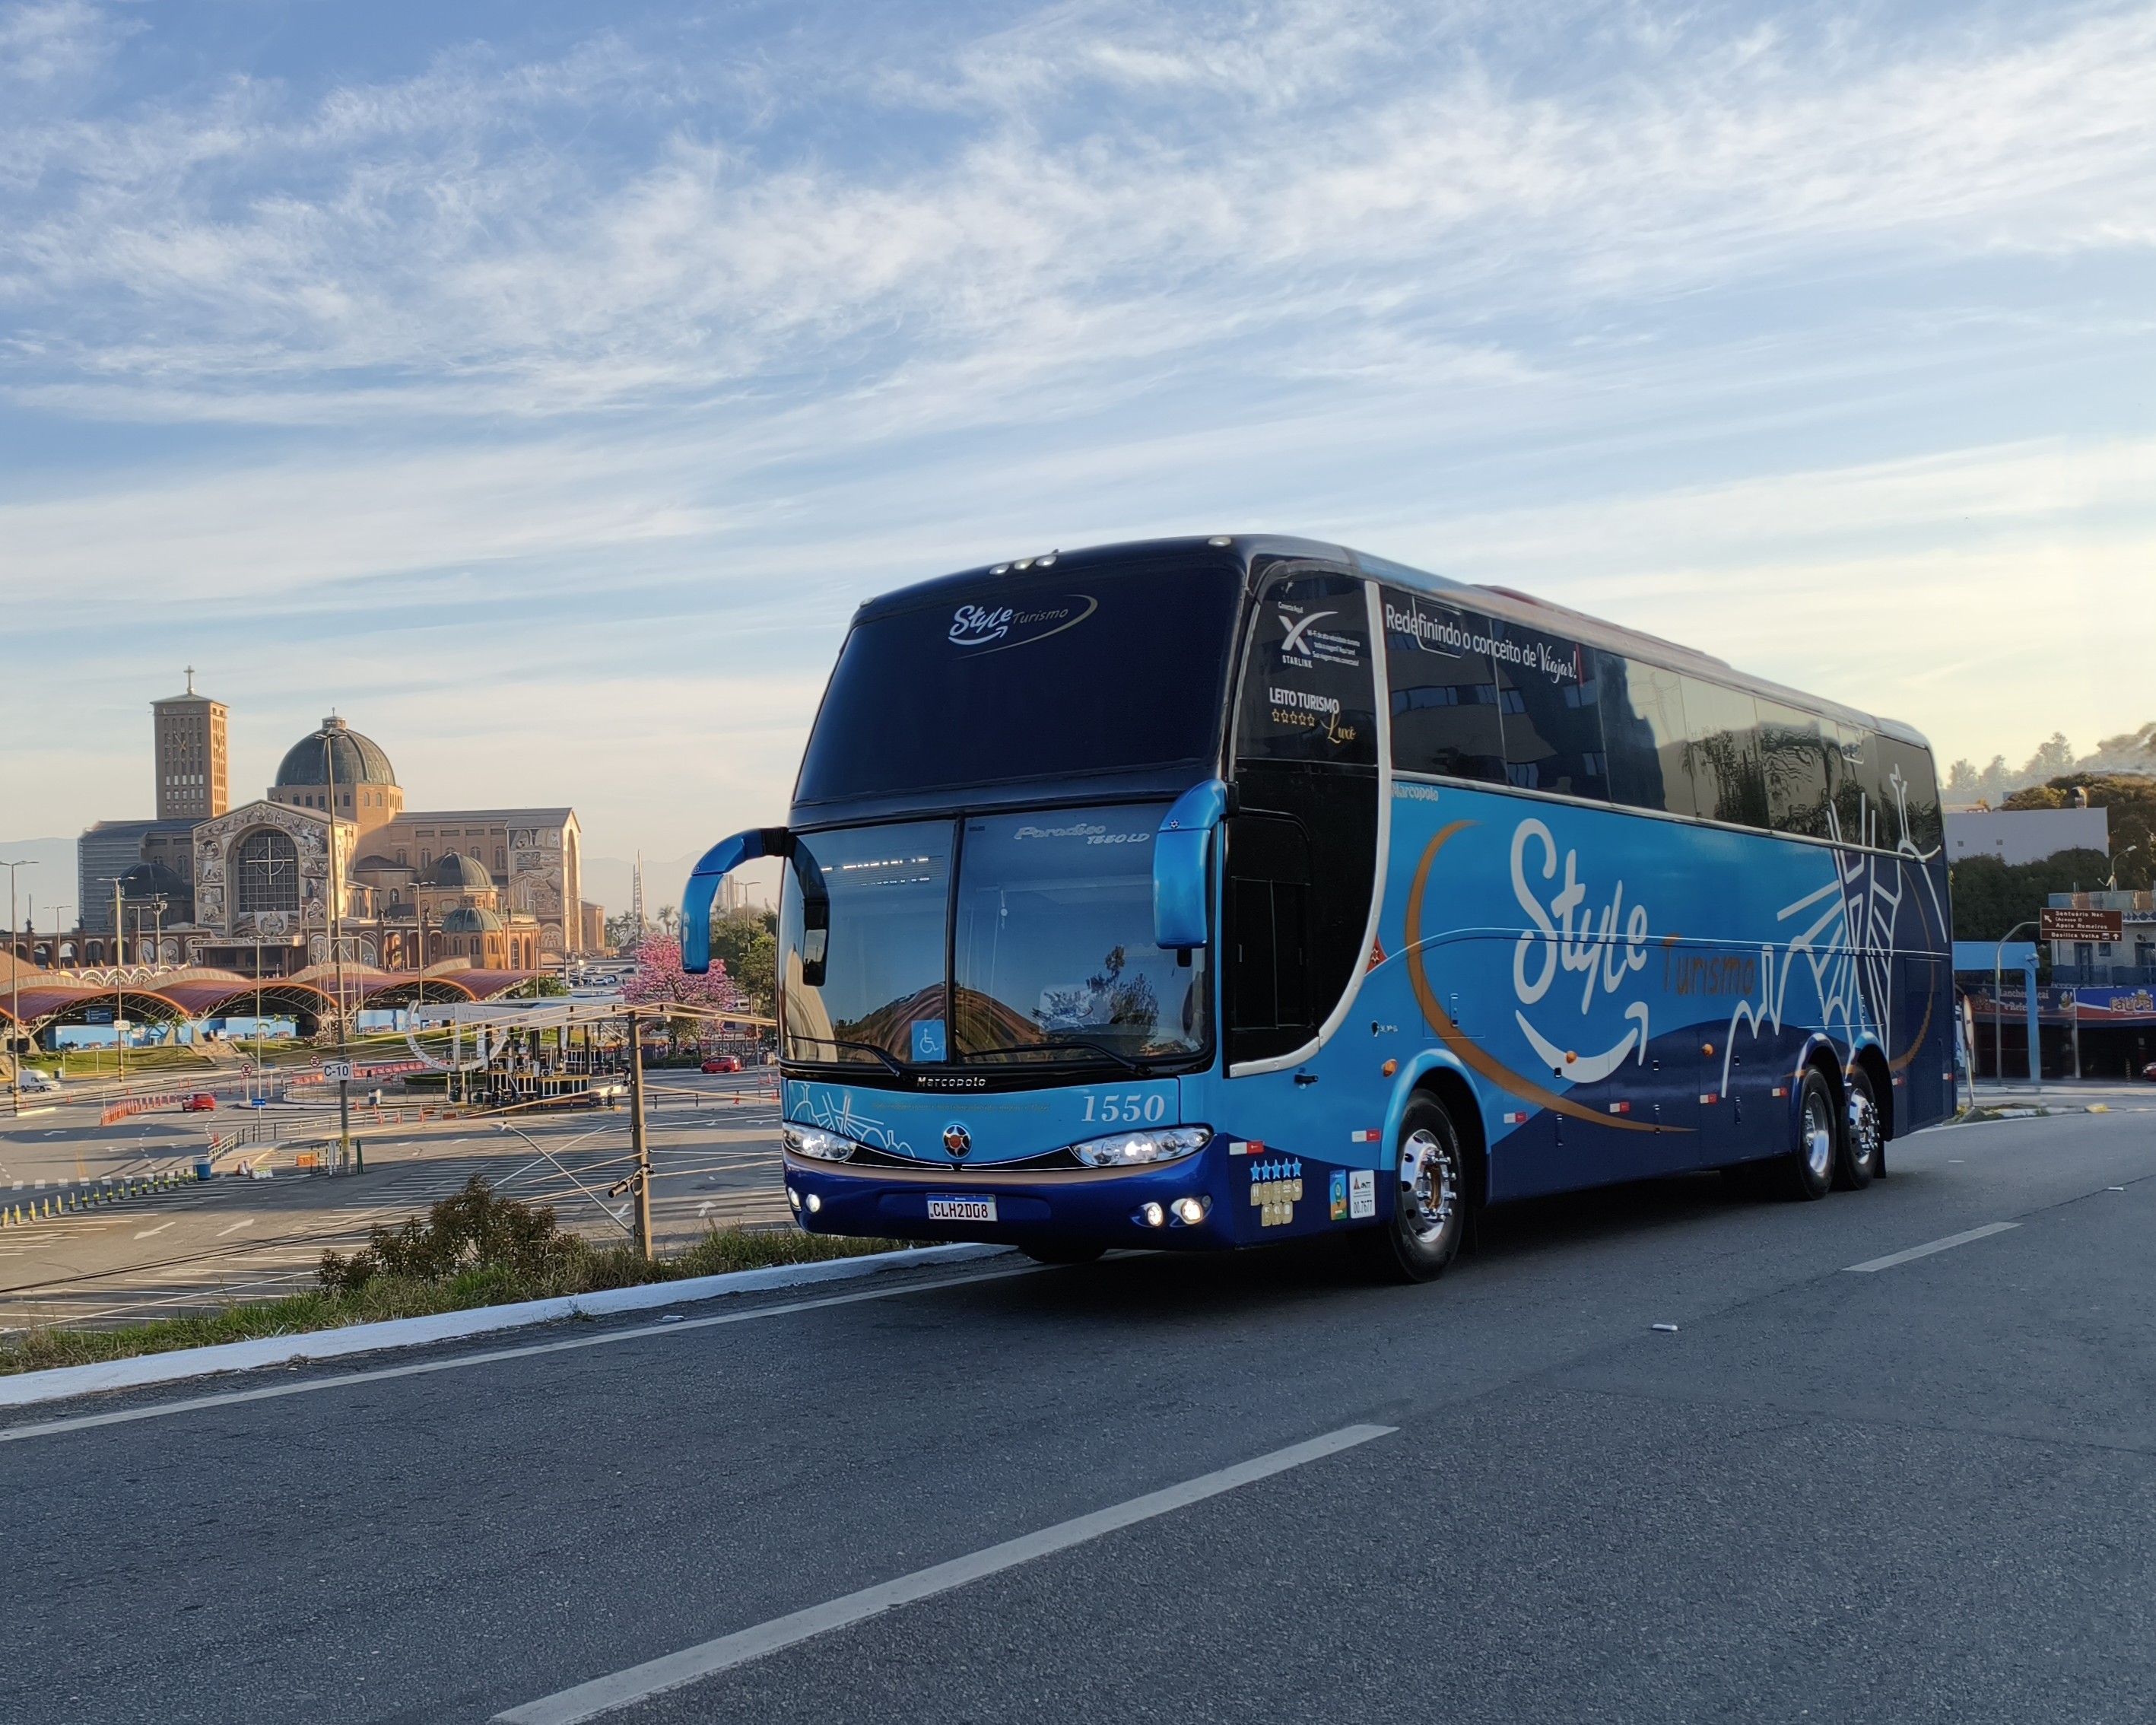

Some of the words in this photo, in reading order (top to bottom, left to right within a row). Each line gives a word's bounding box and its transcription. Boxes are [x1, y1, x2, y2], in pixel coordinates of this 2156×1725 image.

[949, 605, 1013, 637] Style
[1013, 609, 1068, 624] Turismo
[1386, 604, 1461, 646] Redefinindo
[1463, 634, 1471, 649] o
[1473, 635, 1520, 663] conceito
[1523, 645, 1536, 667] de
[1537, 643, 1577, 683] Viajar!
[1282, 655, 1313, 668] STARLINK
[1269, 687, 1297, 707] LEITO
[1297, 692, 1339, 714] TURISMO
[1391, 781, 1439, 802] Marcopolo
[1510, 818, 1648, 1015] Style
[1662, 932, 1754, 996] Turismo
[324, 1066, 349, 1076] C-10
[917, 1076, 986, 1088] Marcopolo
[1081, 1094, 1165, 1122] 1550
[933, 1202, 988, 1218] CLH2D08
